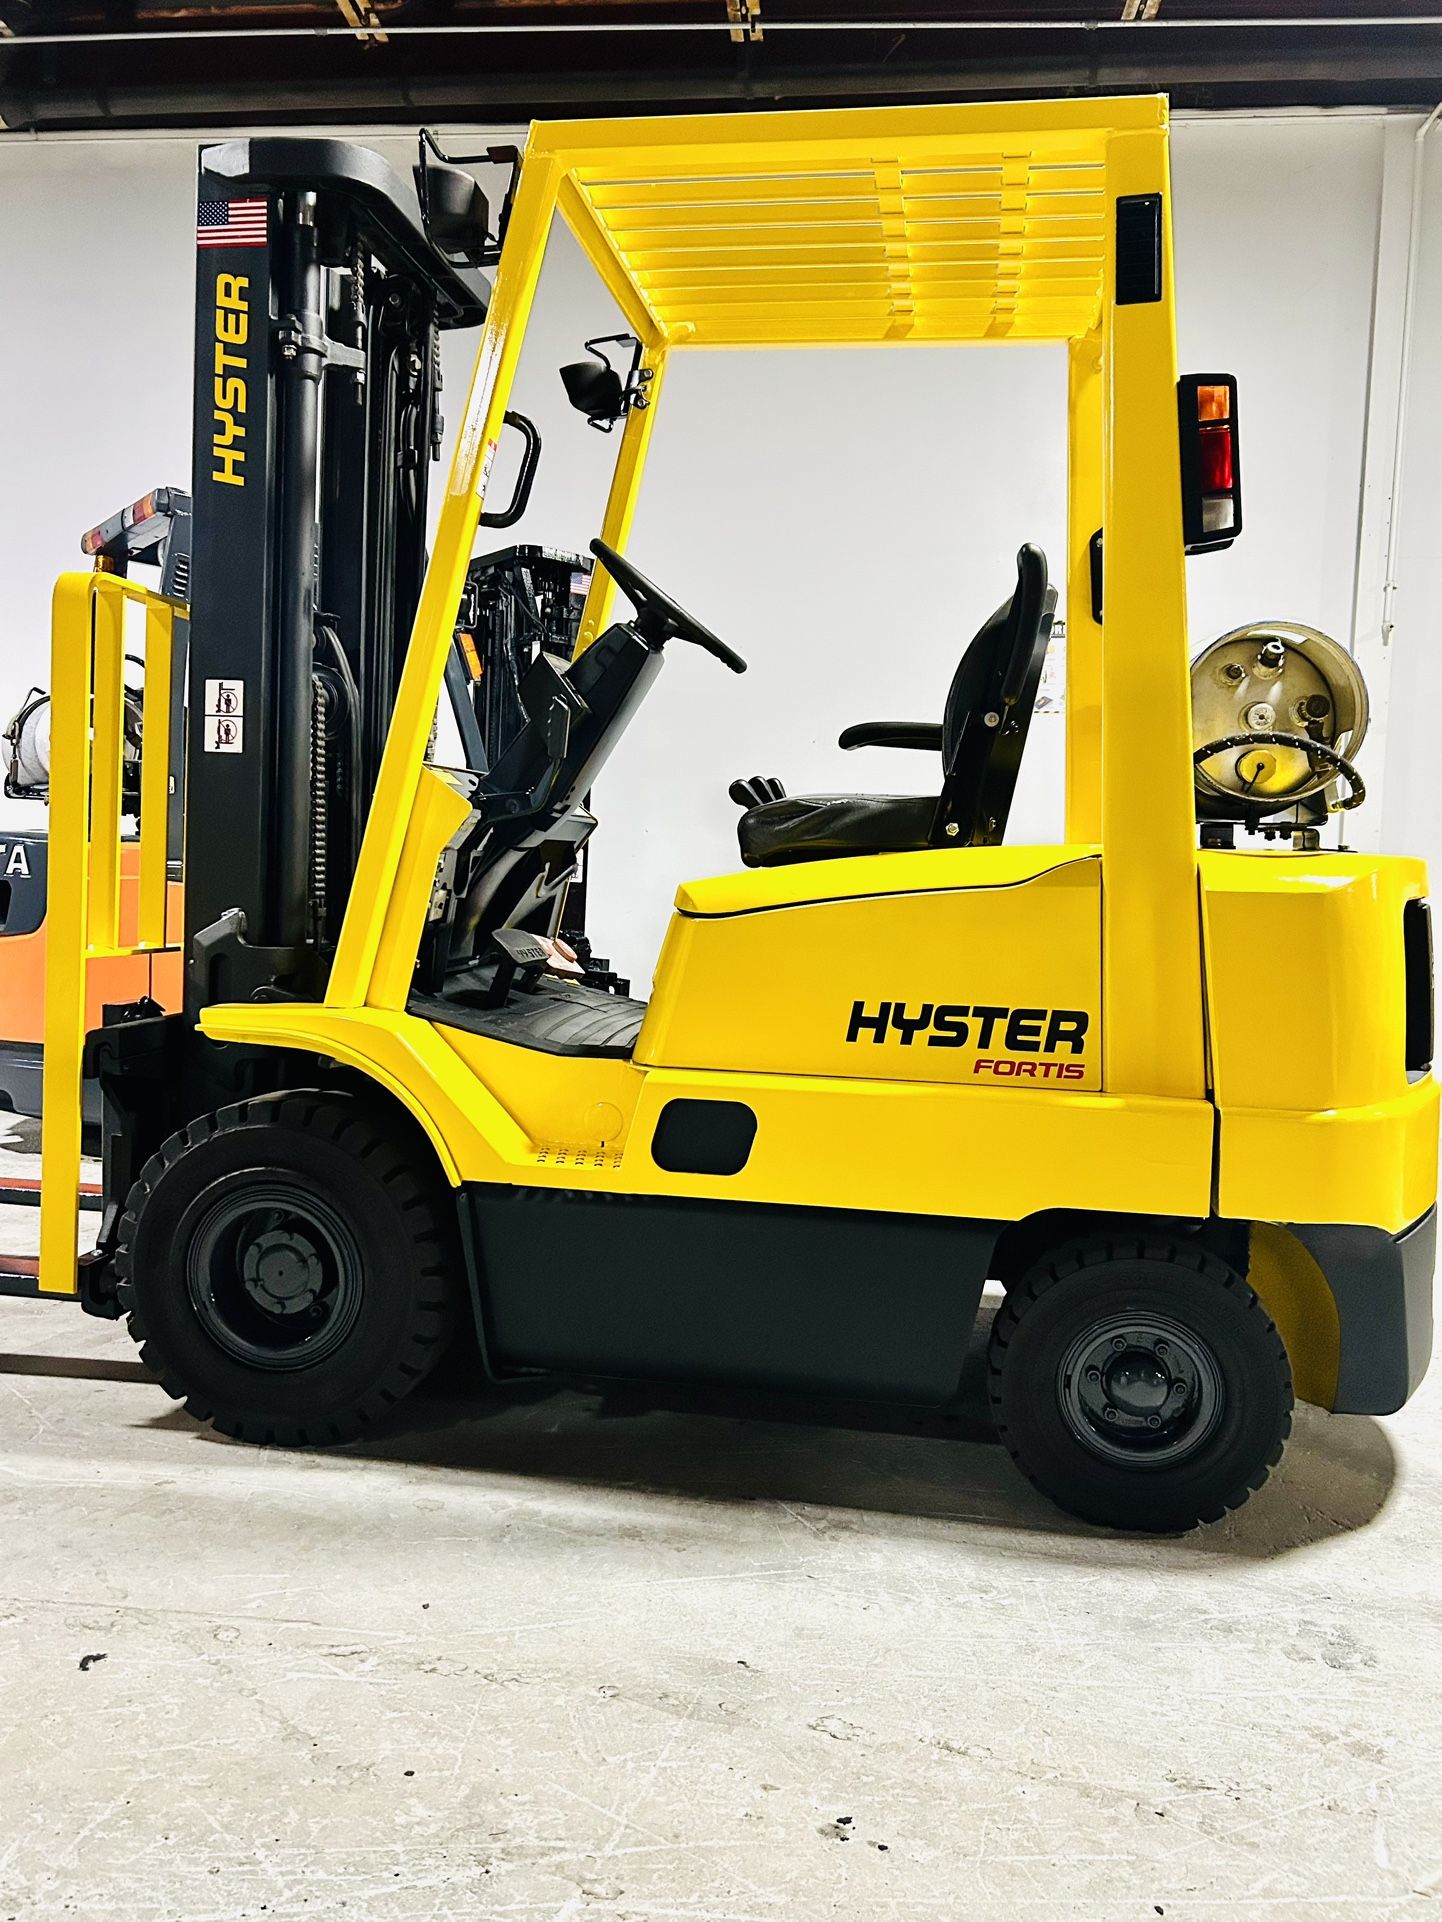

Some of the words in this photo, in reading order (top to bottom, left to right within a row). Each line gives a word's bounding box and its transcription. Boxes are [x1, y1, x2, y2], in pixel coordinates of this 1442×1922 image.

[213, 273, 249, 486] HYSTER
[0, 843, 30, 875] A
[846, 1001, 1089, 1054] HYSTER
[973, 1058, 1086, 1080] FORTIS
